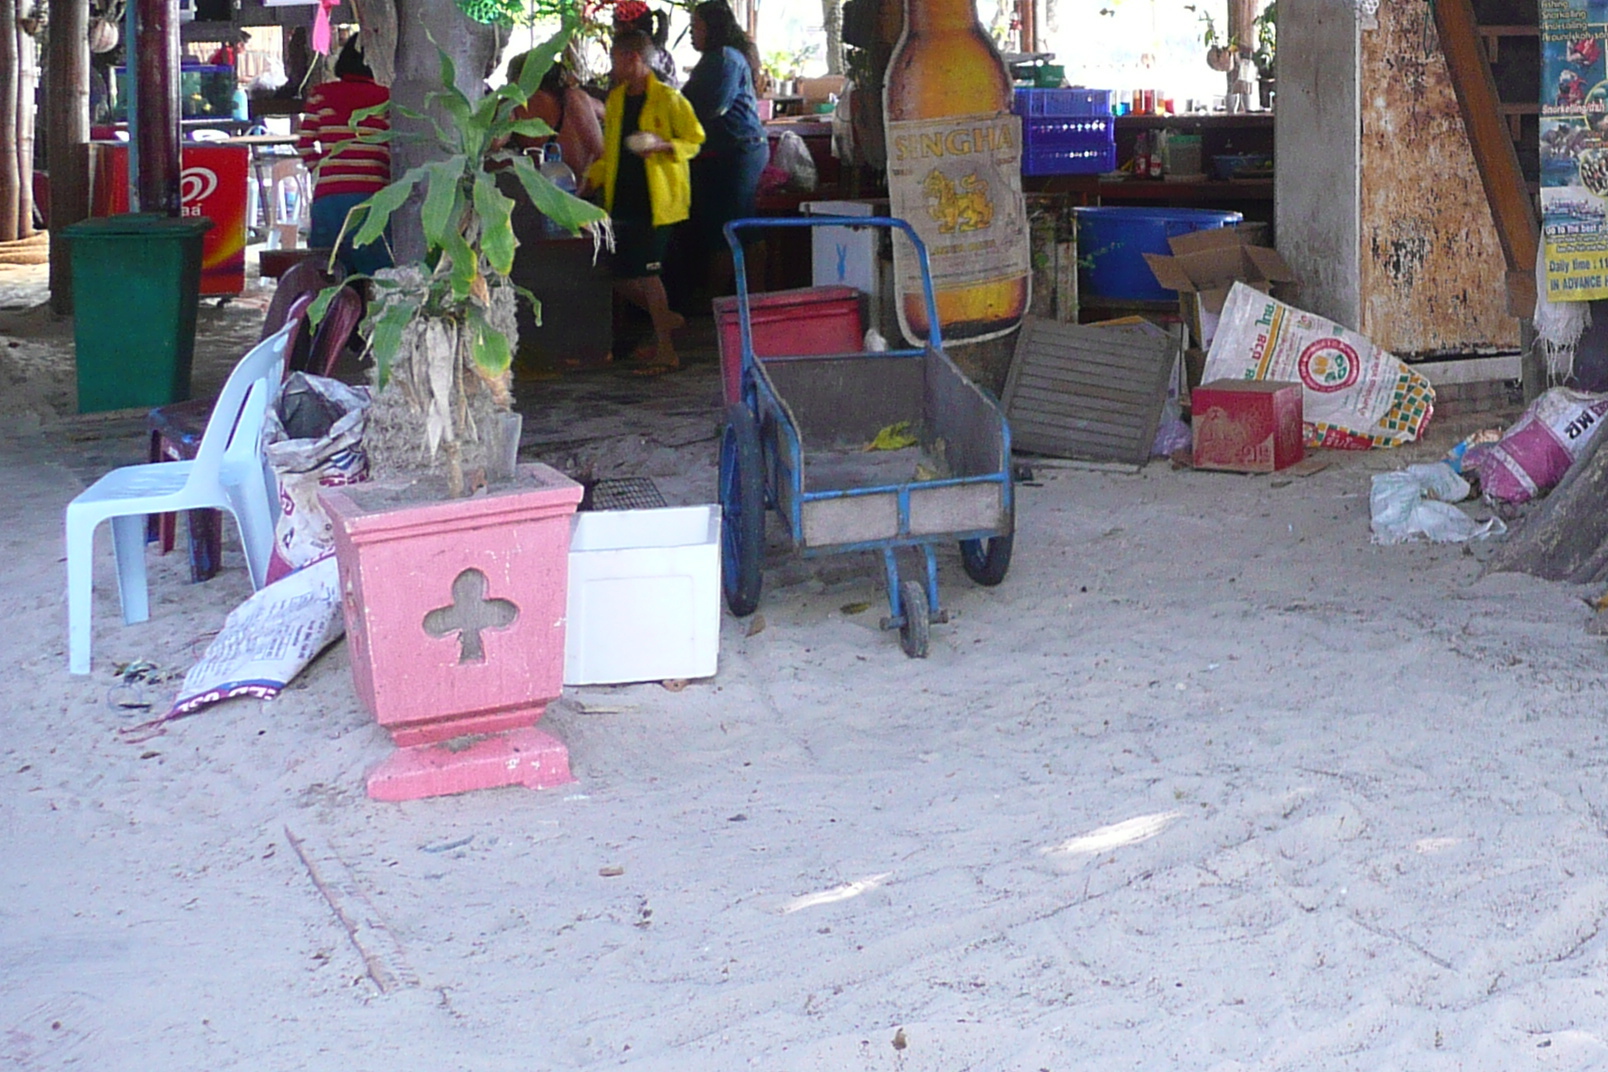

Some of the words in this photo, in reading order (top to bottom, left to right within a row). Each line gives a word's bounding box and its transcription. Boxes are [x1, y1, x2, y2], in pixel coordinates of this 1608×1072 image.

[895, 123, 1013, 161] SINGHA
[1557, 225, 1566, 234] to
[1582, 223, 1597, 232] best
[1550, 259, 1569, 273] Daily
[1573, 257, 1591, 269] time
[1551, 279, 1560, 291] IN
[1563, 275, 1602, 290] ADVANCE
